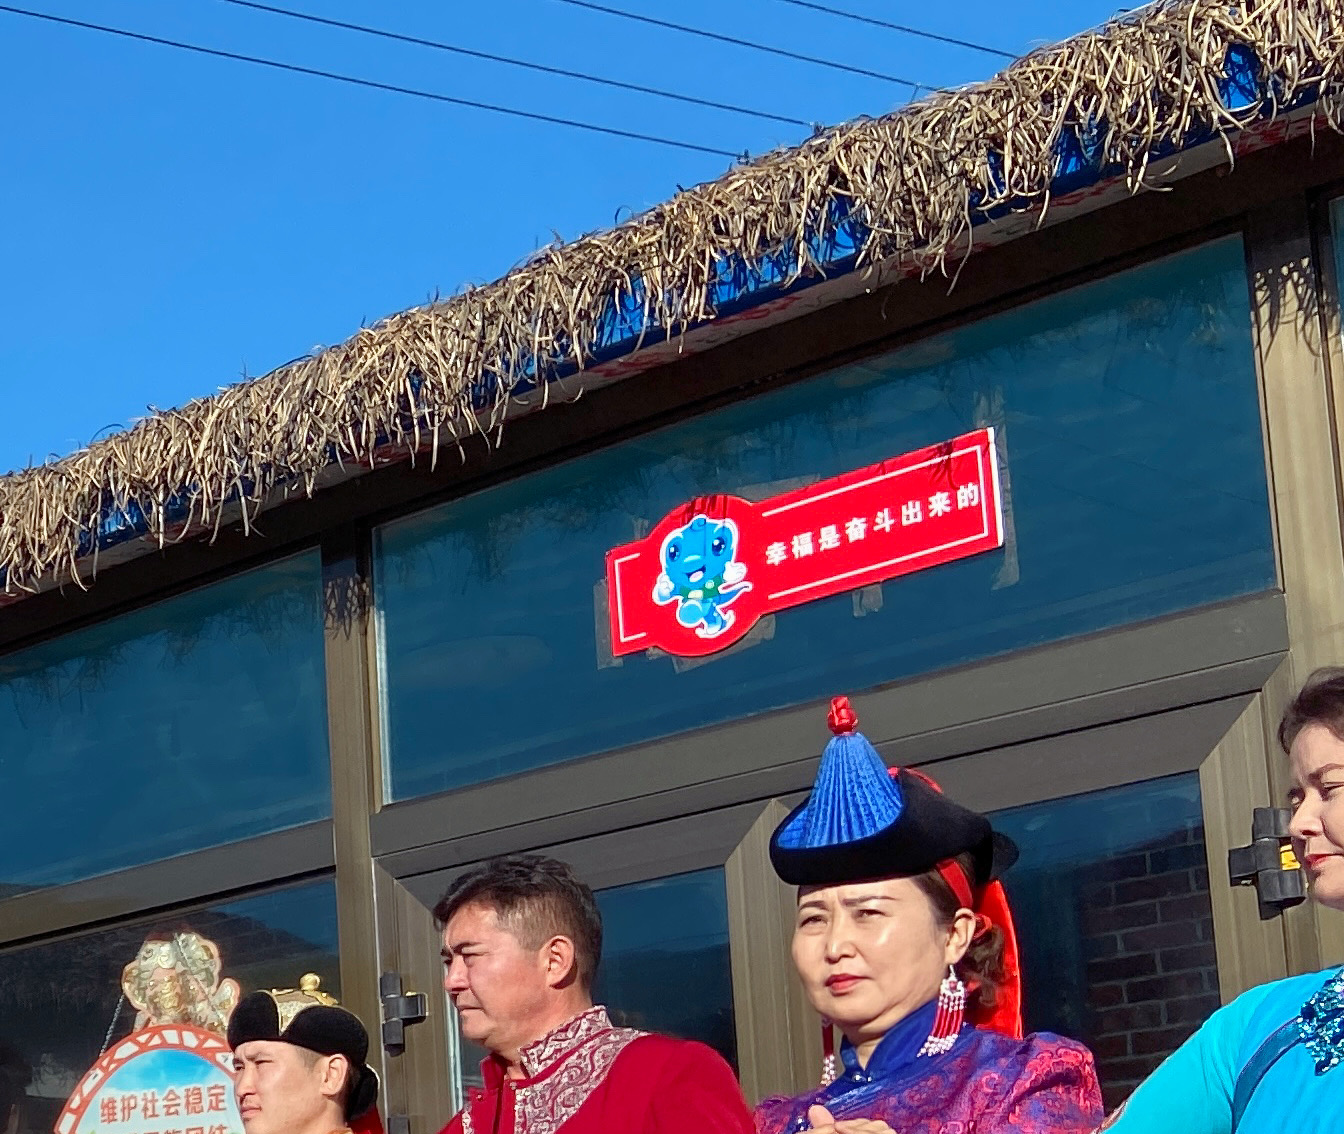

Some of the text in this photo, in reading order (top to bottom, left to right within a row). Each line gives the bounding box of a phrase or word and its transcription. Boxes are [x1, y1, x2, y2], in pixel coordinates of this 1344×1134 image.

[765, 482, 980, 567] 幸福是奋斗出来的
[99, 1083, 227, 1125] 维护社会稳定
